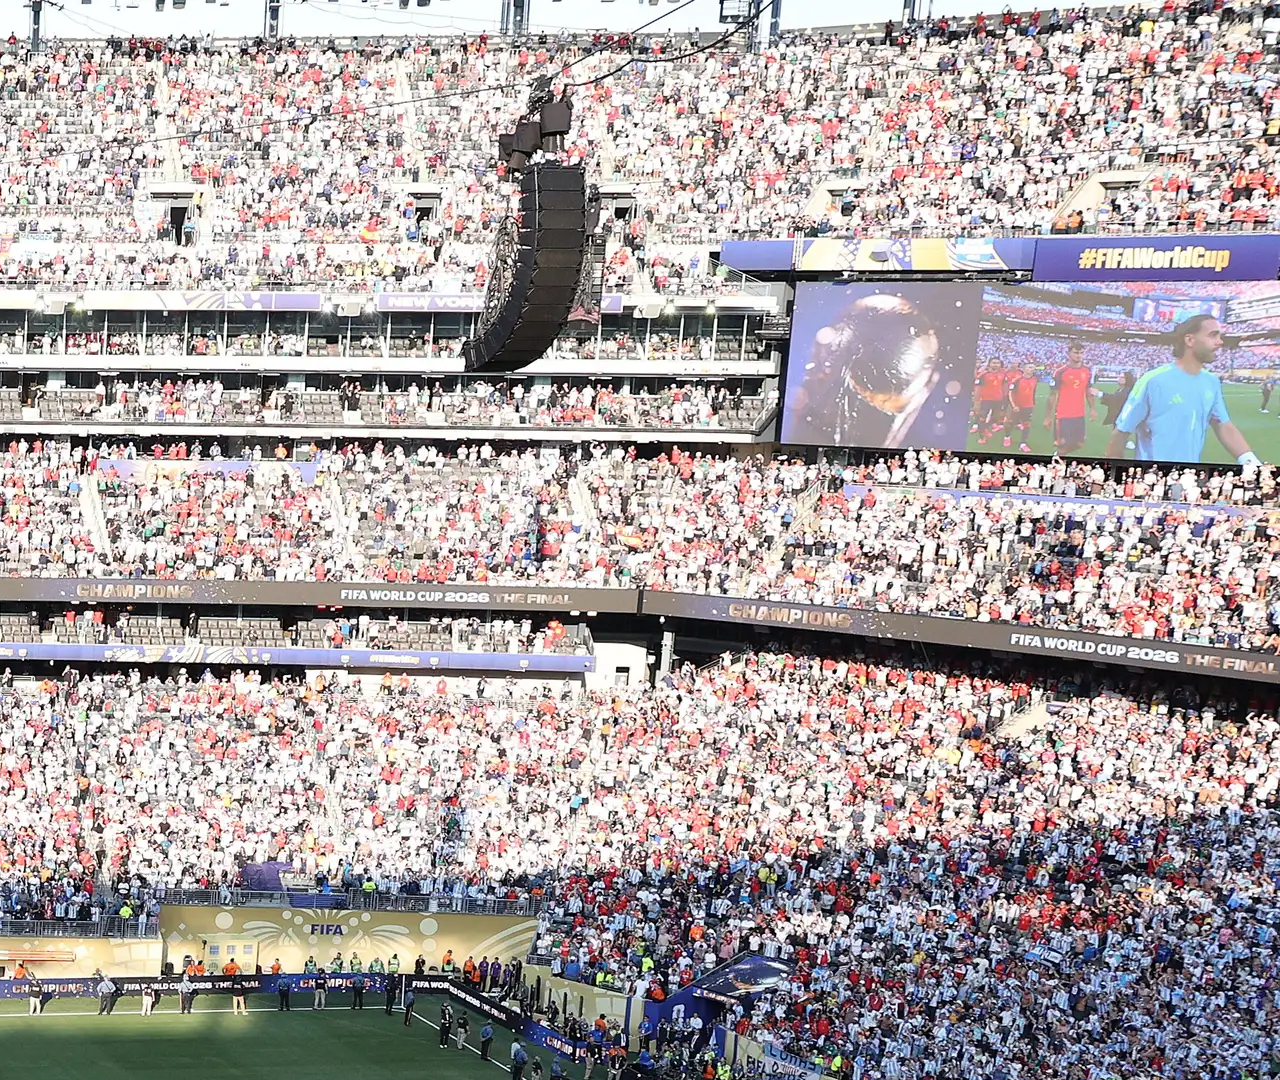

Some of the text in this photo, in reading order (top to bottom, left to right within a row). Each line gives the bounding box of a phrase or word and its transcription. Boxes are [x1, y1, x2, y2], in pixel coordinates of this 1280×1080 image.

[1078, 246, 1230, 272] #FIFAWorldCup
[77, 584, 192, 598] CHAMPIONS
[340, 590, 573, 604] FIFA WORLD CUP 2026 THE FINAL
[729, 603, 852, 628] CHAMPIONS
[1011, 633, 1278, 674] FIFA WORLD CUP 2026 THE FINAL
[311, 924, 343, 935] FIFA
[13, 983, 84, 993] CHMPIONS
[412, 980, 429, 989] FIFA
